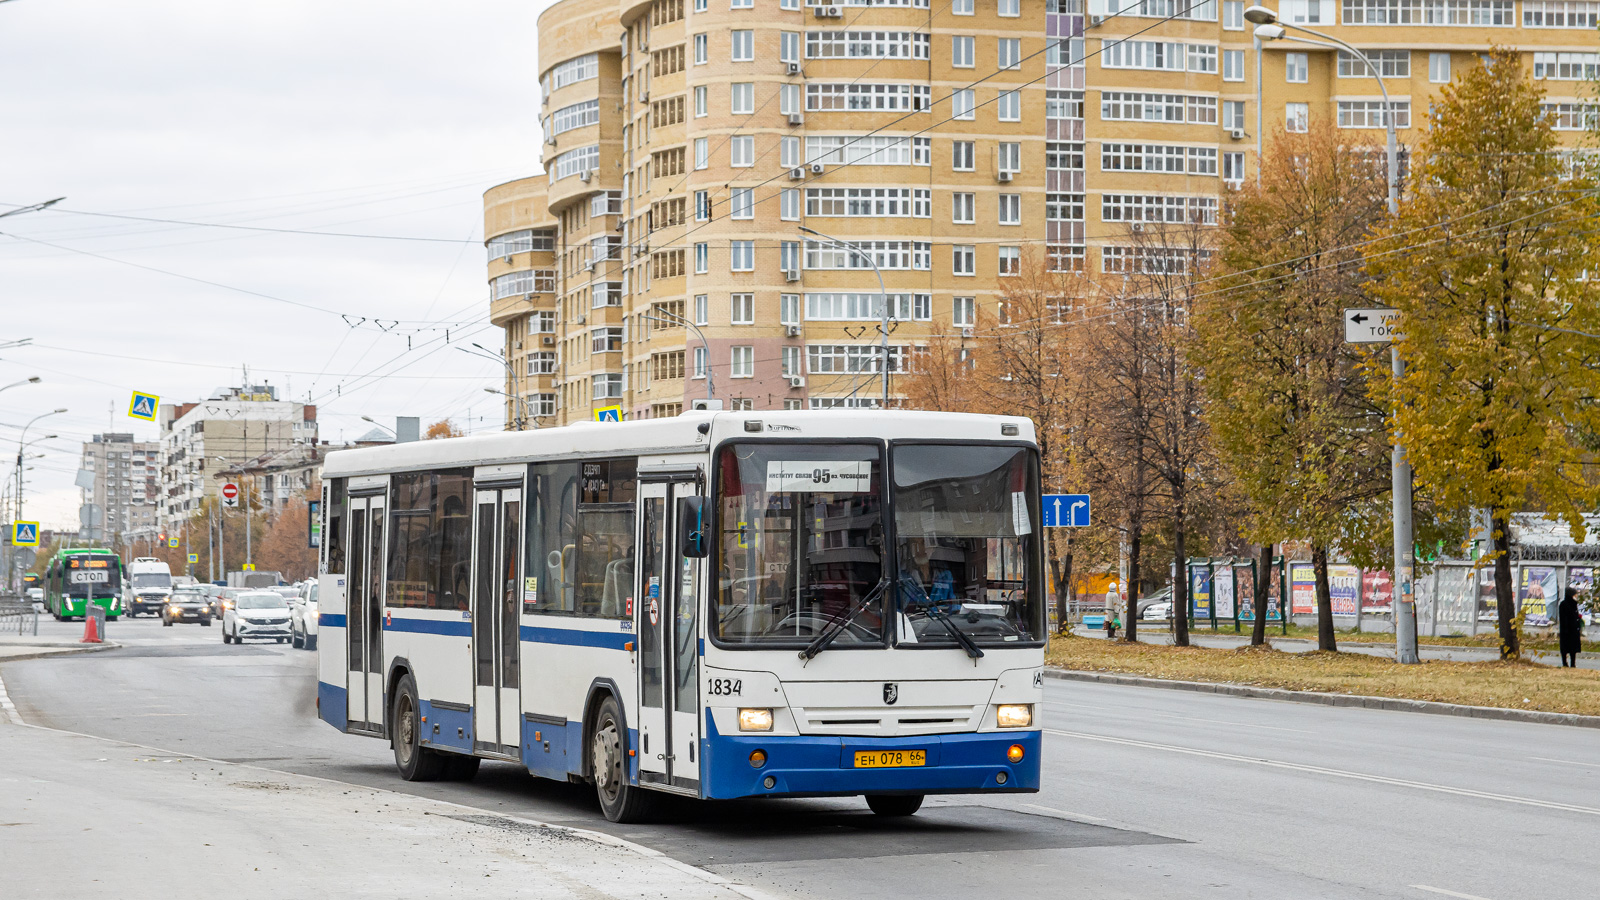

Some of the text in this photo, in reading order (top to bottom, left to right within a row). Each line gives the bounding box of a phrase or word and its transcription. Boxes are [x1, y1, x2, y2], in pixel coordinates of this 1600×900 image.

[812, 468, 831, 484] 95
[76, 572, 103, 581] СТОП
[708, 678, 742, 697] 1834
[861, 751, 921, 766] ЕН 078 66
